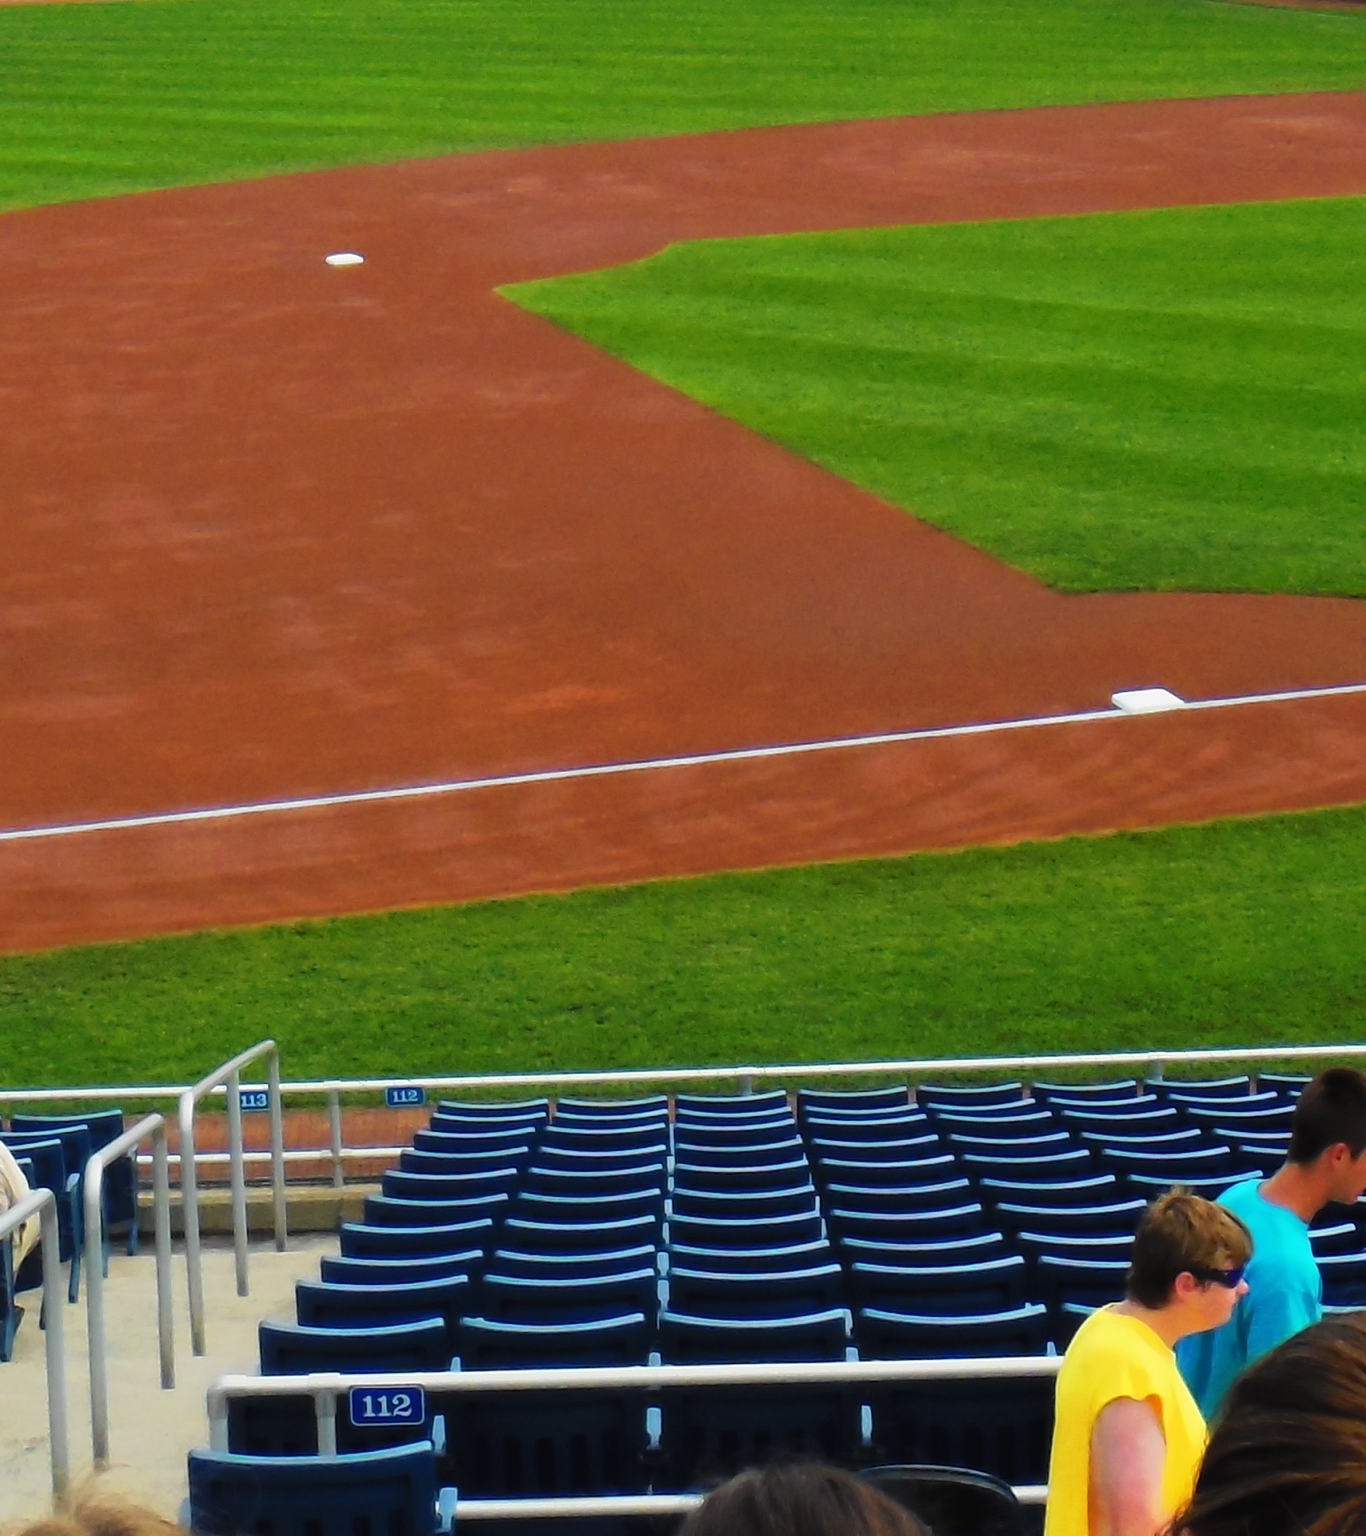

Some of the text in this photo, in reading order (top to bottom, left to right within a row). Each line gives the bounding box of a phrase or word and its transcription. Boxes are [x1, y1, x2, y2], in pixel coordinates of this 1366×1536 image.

[241, 1089, 419, 1108] 113 112
[362, 1393, 413, 1417] 112
